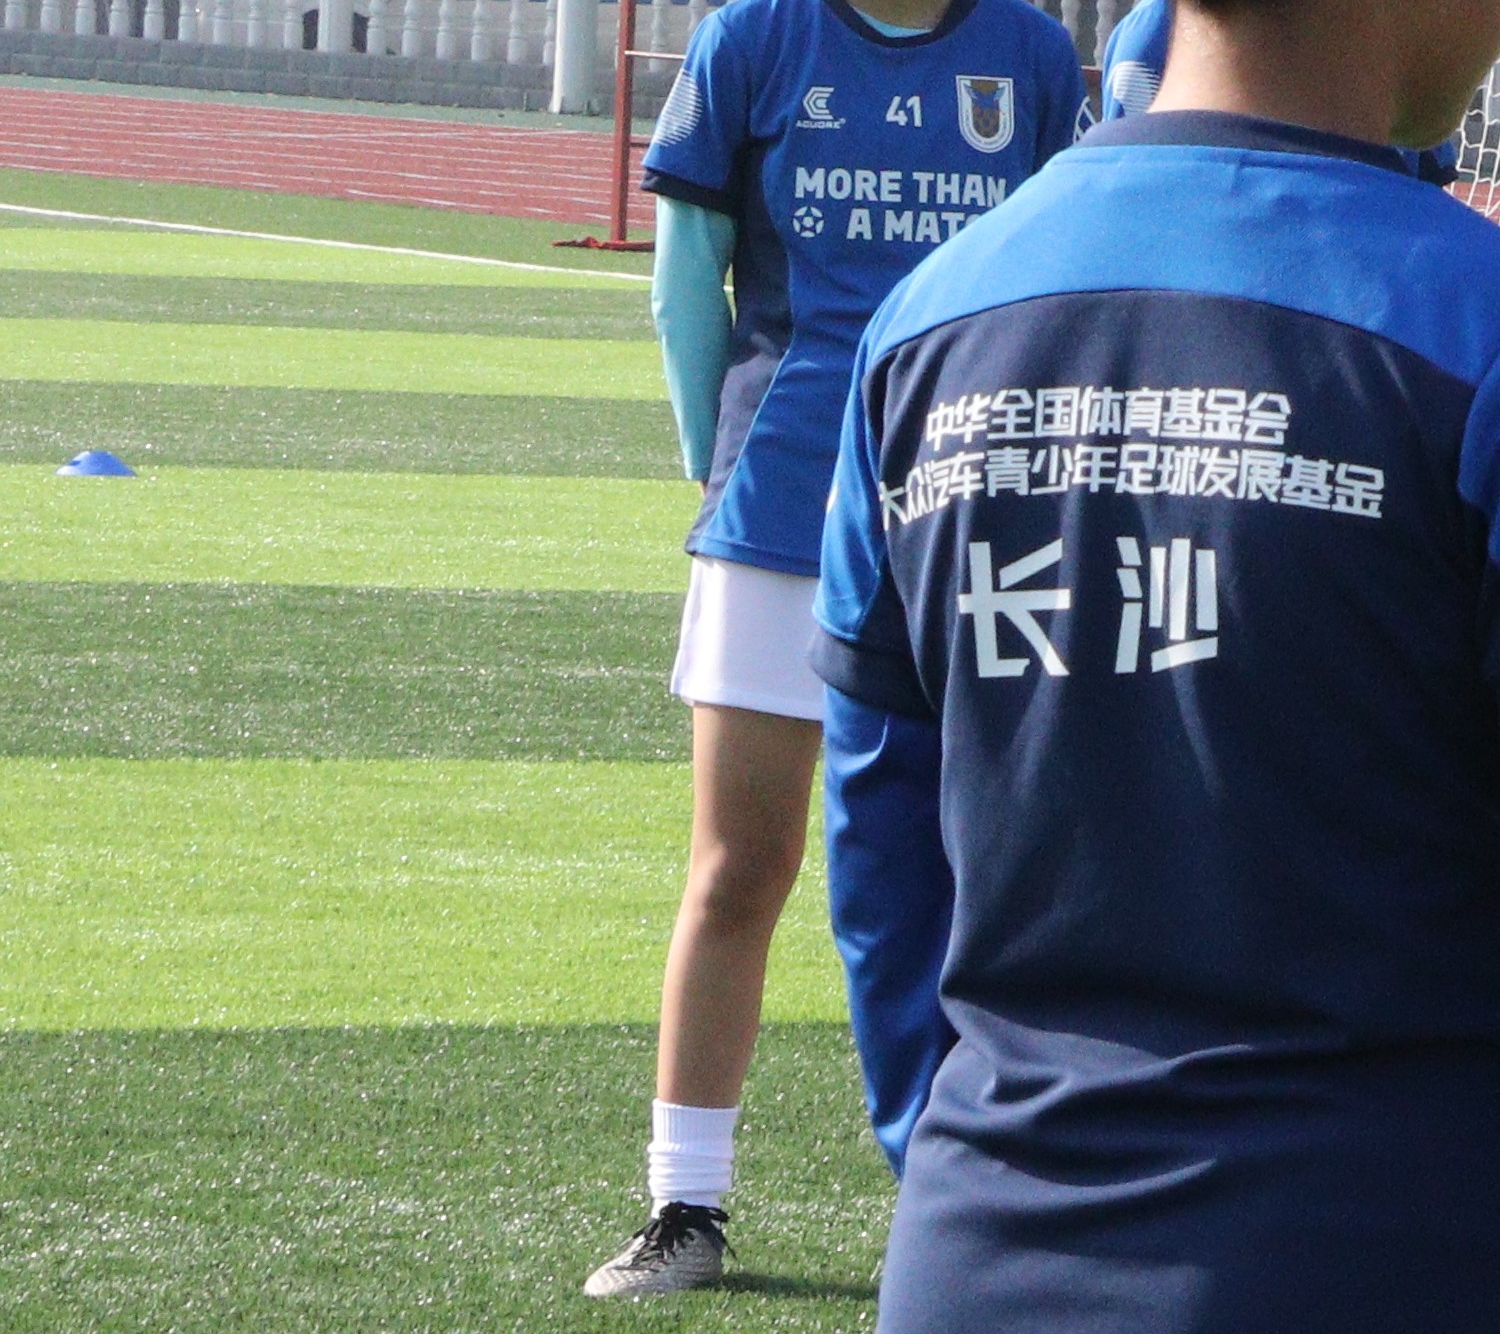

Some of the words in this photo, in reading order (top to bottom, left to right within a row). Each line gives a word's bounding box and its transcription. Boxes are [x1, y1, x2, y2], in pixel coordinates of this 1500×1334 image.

[885, 95, 922, 128] 41
[794, 166, 903, 203] MORE
[912, 171, 1007, 208] THAN
[846, 207, 873, 241] A
[885, 208, 981, 244] MAT
[926, 385, 1292, 452] 中华全国体育基金会
[879, 443, 1386, 531] 大众汽车青少年足球发展基金
[958, 535, 1219, 678] 长沙
